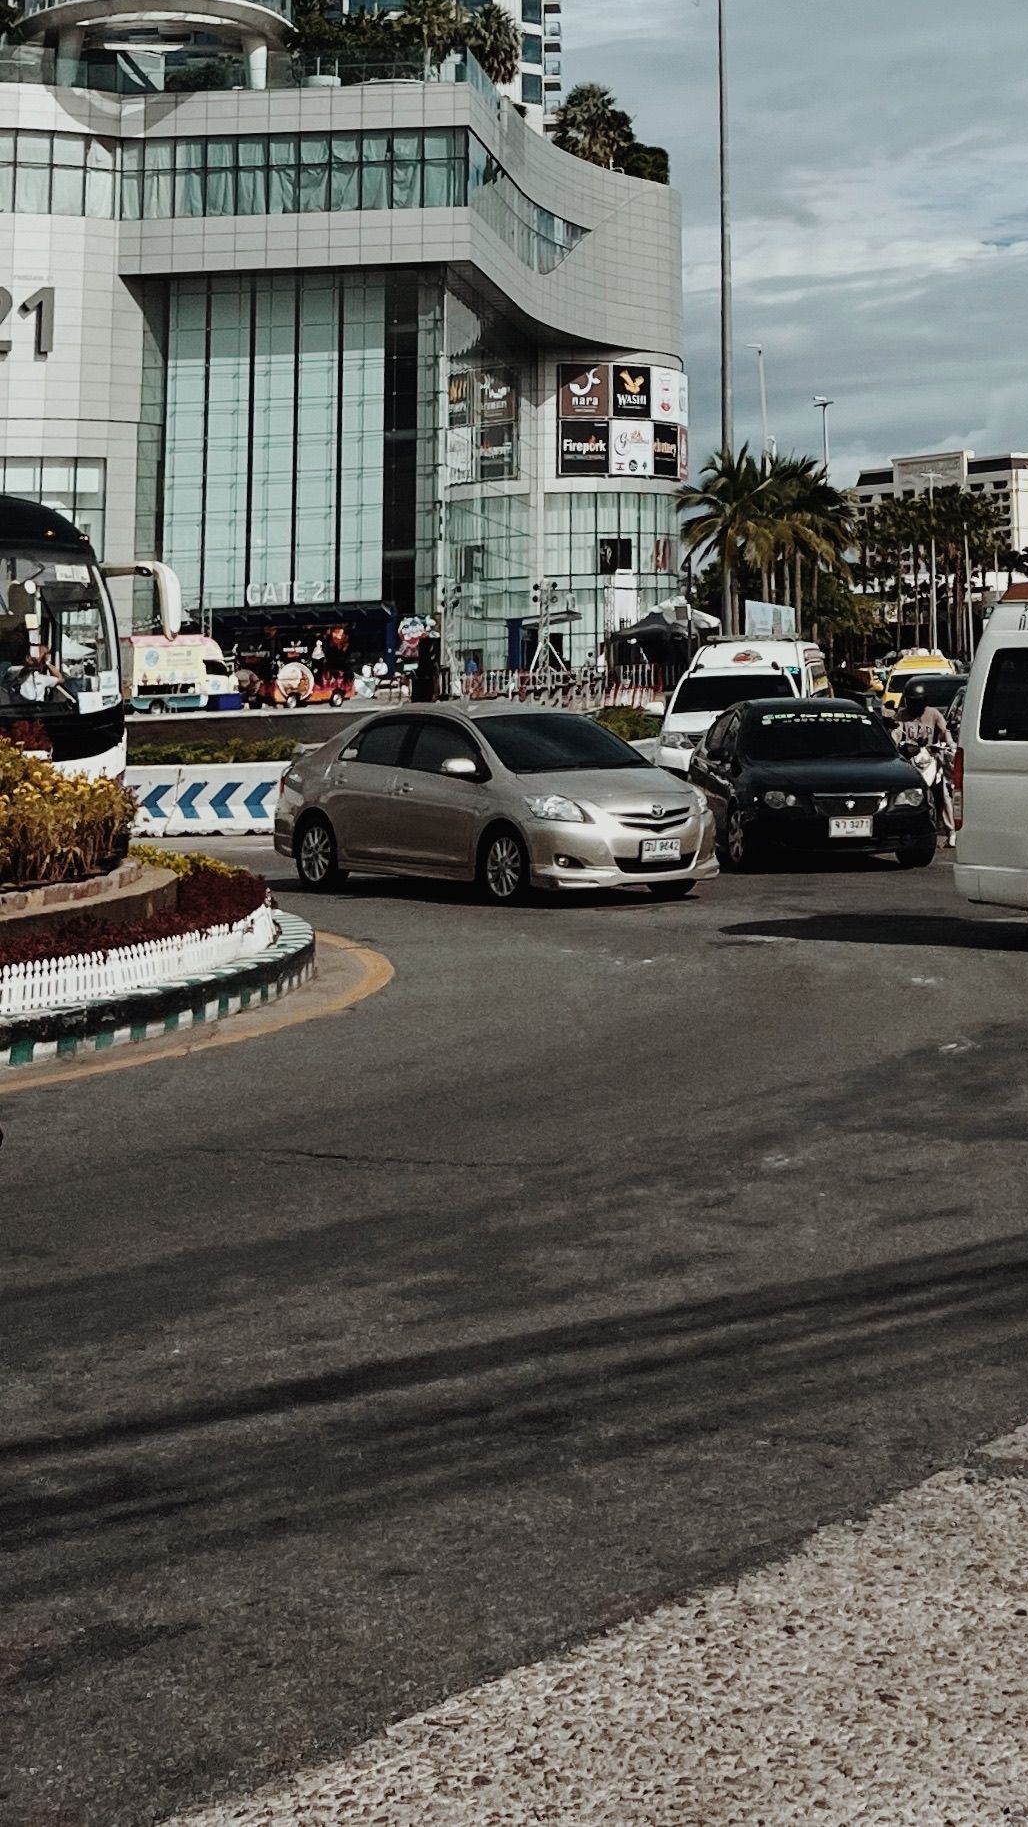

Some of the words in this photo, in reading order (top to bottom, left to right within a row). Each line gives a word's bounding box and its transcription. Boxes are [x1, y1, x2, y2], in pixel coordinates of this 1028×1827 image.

[571, 396, 599, 406] nara
[617, 394, 647, 406] WASHI
[563, 438, 607, 455] Firepork
[246, 581, 306, 604] GATE
[311, 580, 325, 602] 2
